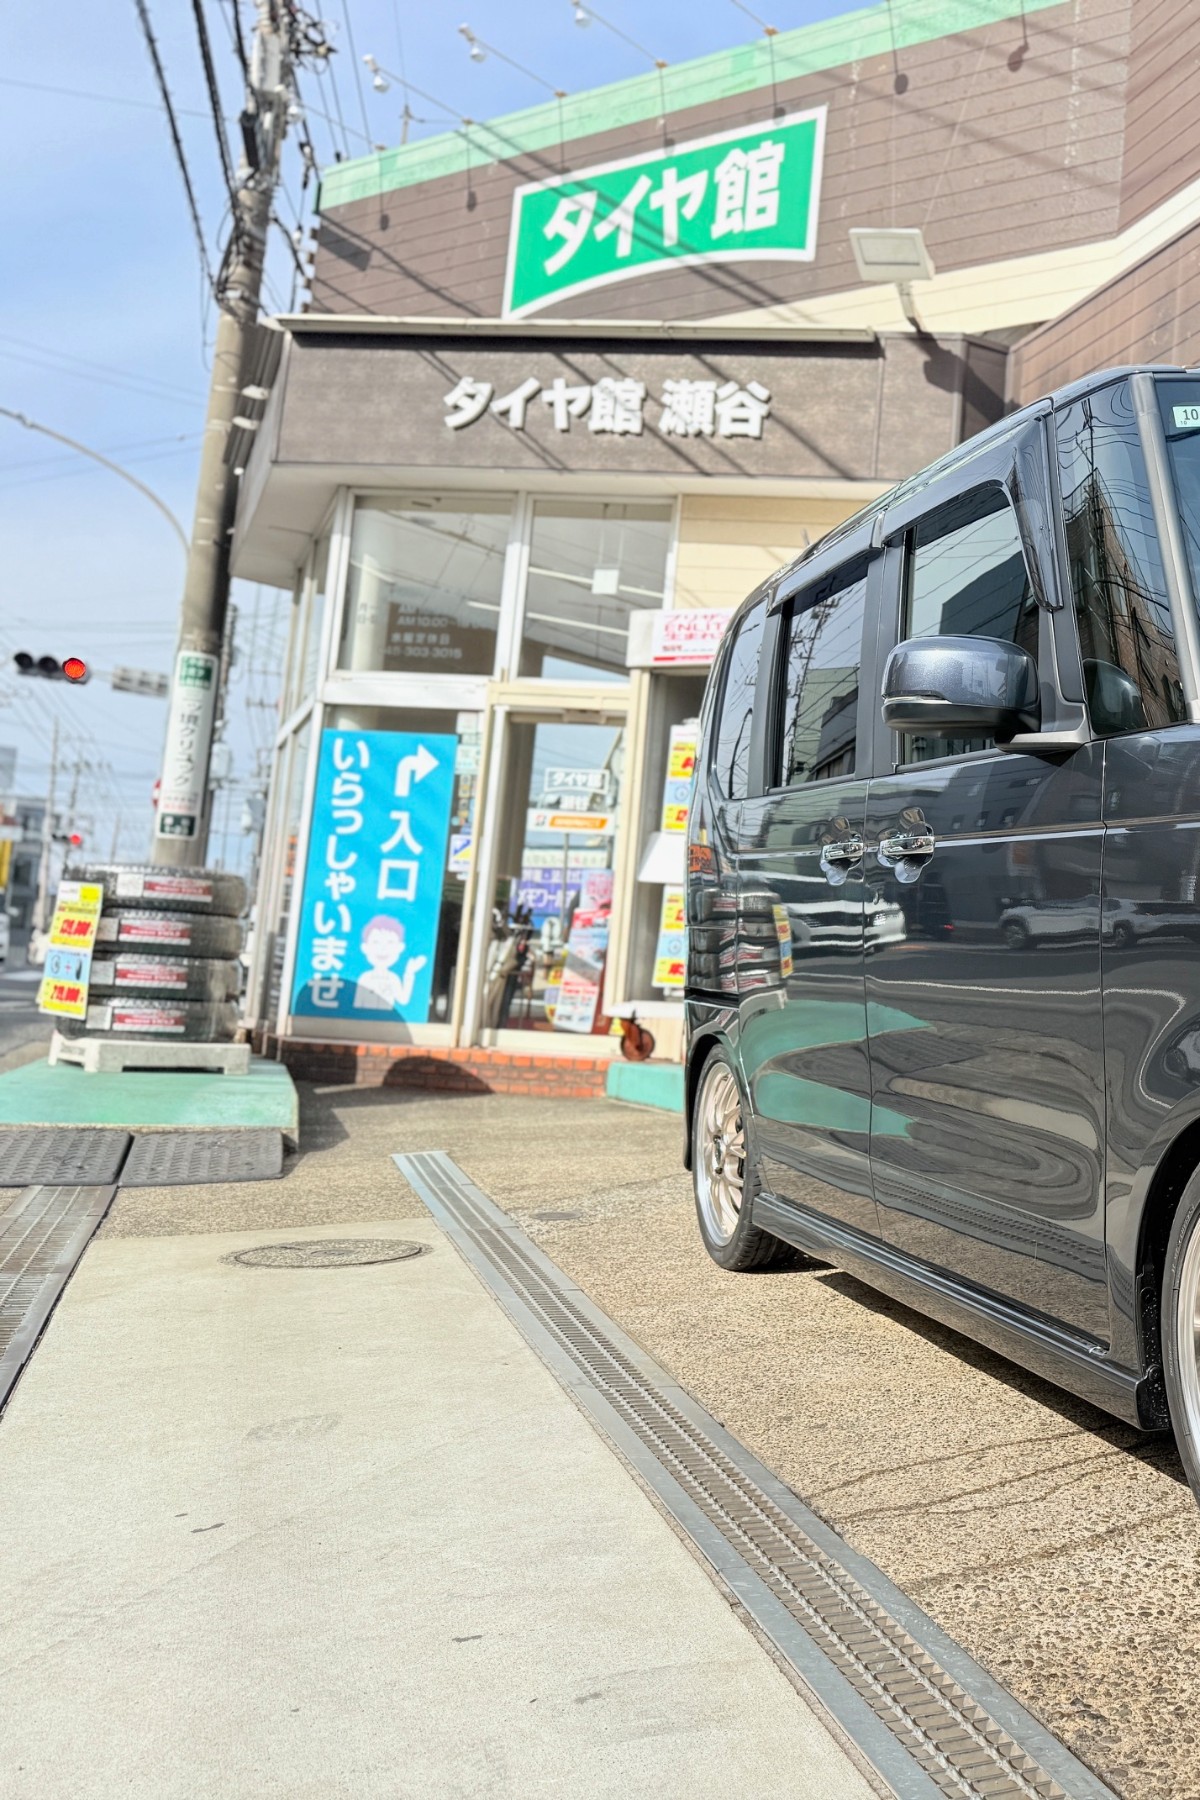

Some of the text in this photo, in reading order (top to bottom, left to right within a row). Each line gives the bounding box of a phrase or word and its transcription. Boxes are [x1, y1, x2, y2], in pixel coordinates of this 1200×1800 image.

[542, 140, 786, 277] タイヤ館
[443, 376, 772, 439] タイヤ館 瀬谷
[1183, 409, 1199, 420] 10
[307, 737, 370, 1009] いらっしゃいませ
[376, 810, 423, 902] 入口
